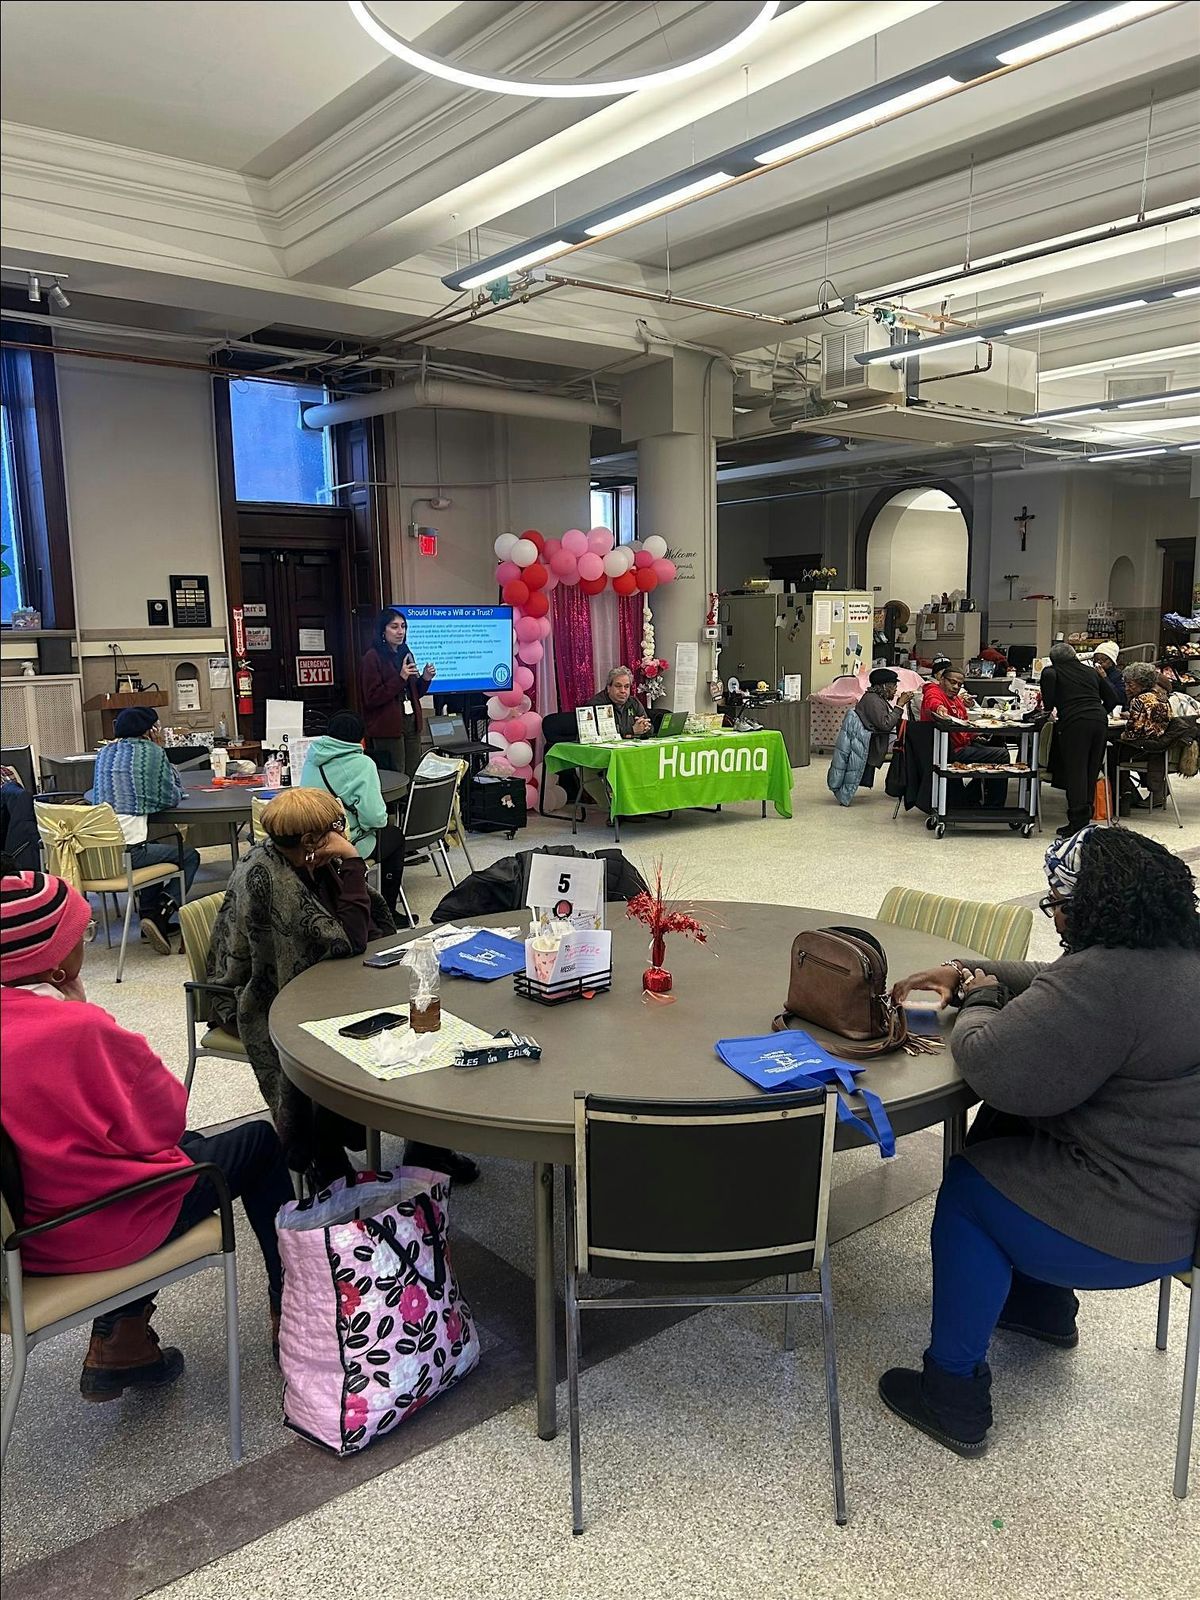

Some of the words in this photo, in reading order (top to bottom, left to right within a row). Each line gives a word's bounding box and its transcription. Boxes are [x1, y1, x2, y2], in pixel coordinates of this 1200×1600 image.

[663, 548, 697, 559] Welcome
[300, 660, 330, 668] EMERGENCY
[300, 668, 331, 682] EXIT
[282, 734, 289, 743] 6
[659, 746, 768, 779] Humana
[558, 873, 571, 893] 5
